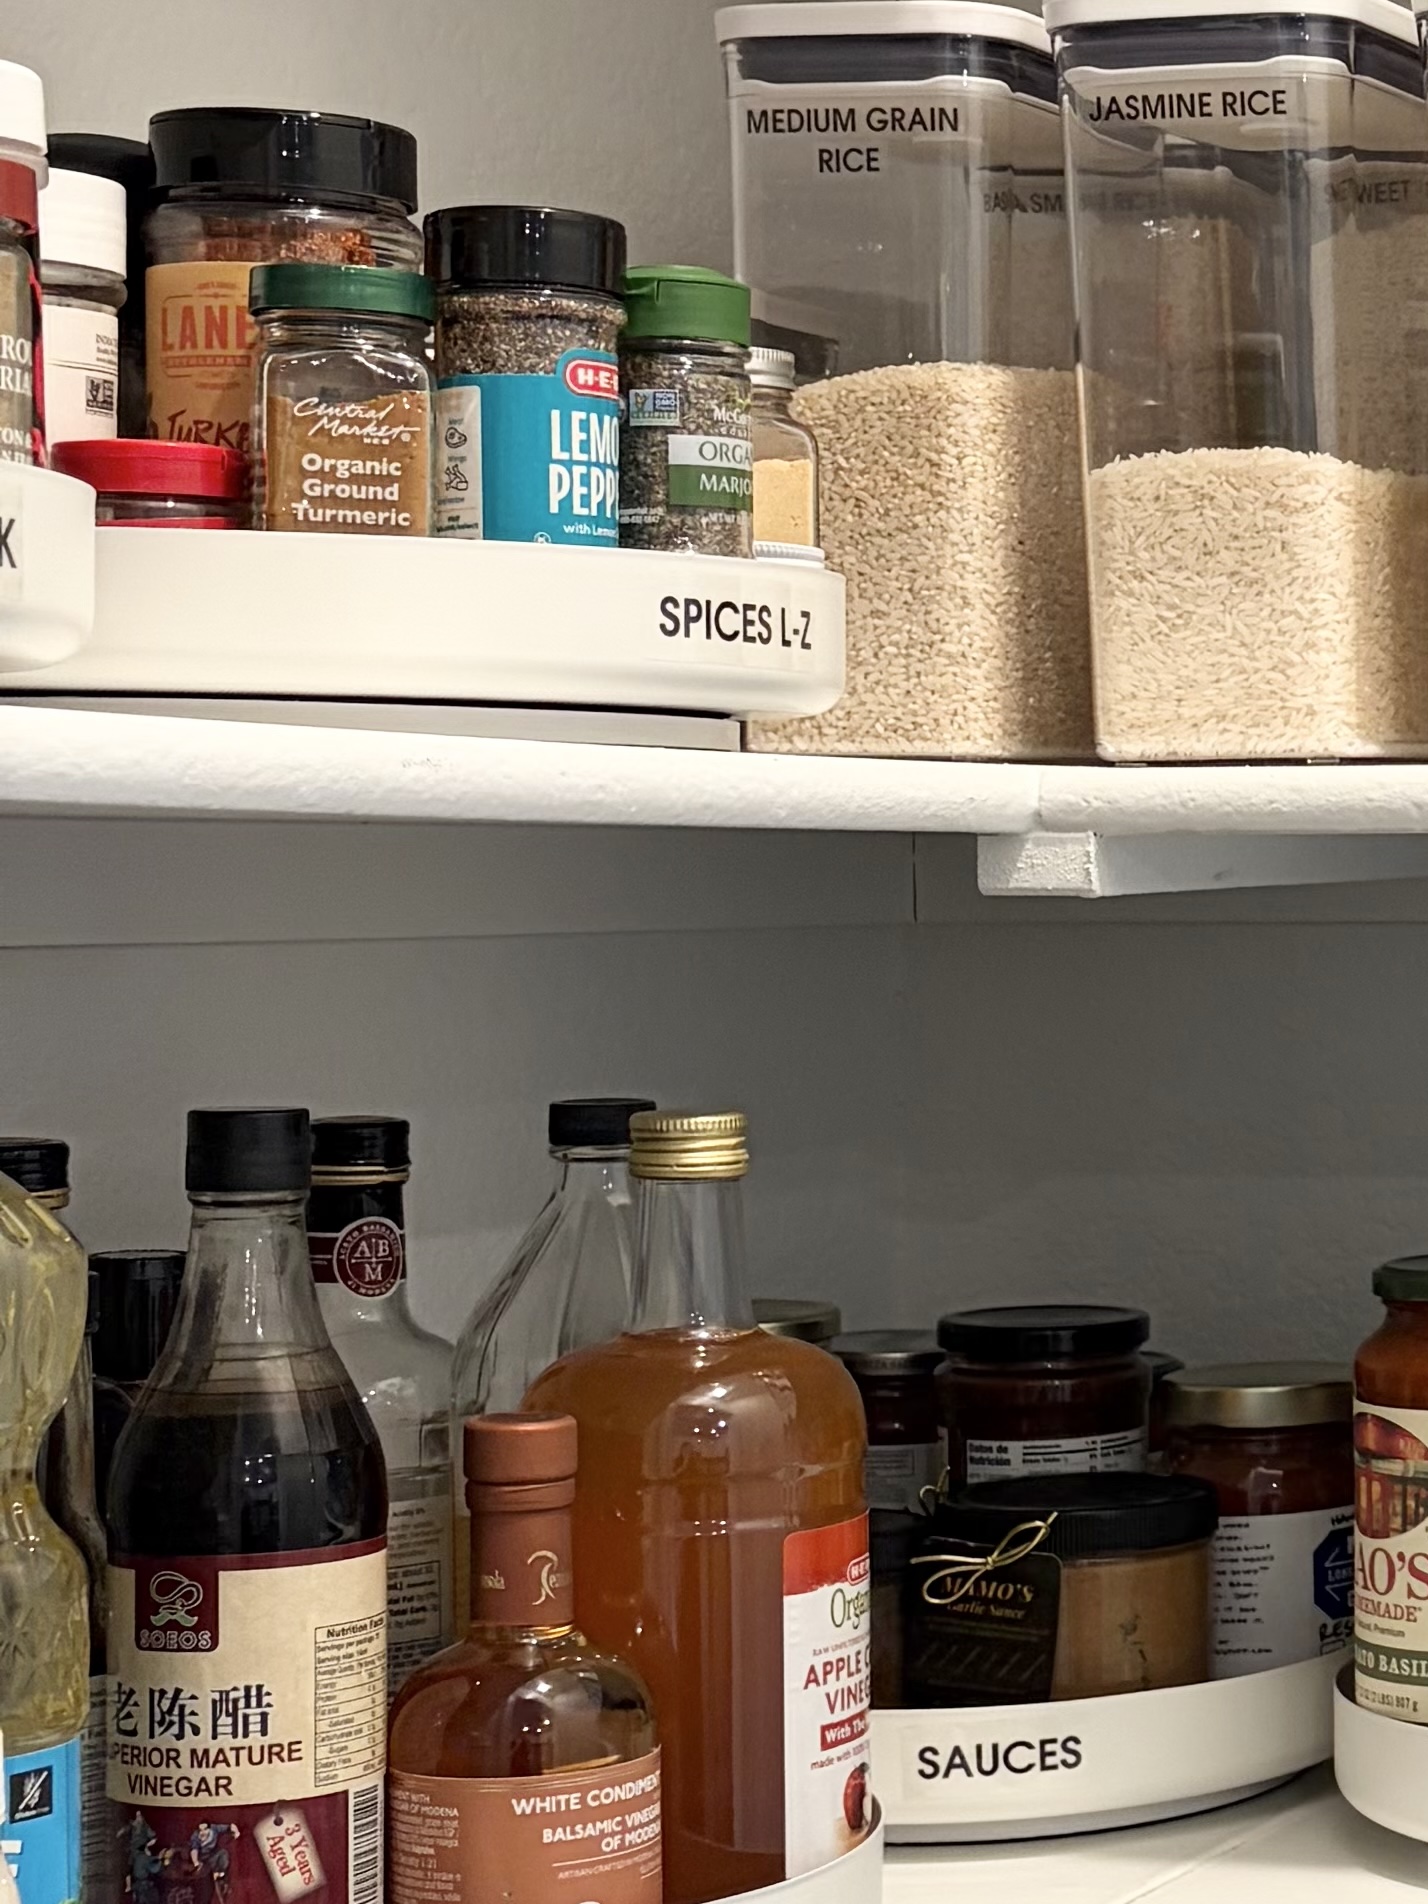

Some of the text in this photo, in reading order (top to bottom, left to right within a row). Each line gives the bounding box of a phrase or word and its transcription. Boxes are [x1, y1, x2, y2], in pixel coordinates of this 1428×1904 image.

[745, 106, 960, 136] MEDIUM GRAIN
[1088, 90, 1288, 124] JASMINE RICE
[817, 147, 881, 175] RICE
[301, 452, 402, 479] Organic
[302, 478, 400, 501] Ground
[291, 502, 412, 527] Turmeric
[658, 594, 812, 651] SPICES L-Z
[802, 1651, 863, 1691] APPLE
[189, 1740, 304, 1769] MATURE
[916, 1735, 1083, 1781] SAUCES
[127, 1775, 234, 1797] VINEGAR
[511, 1792, 582, 1817] WHITE
[542, 1815, 623, 1845] BALSAMIC
[266, 1834, 296, 1877] Aged
[289, 1834, 316, 1886] Years
